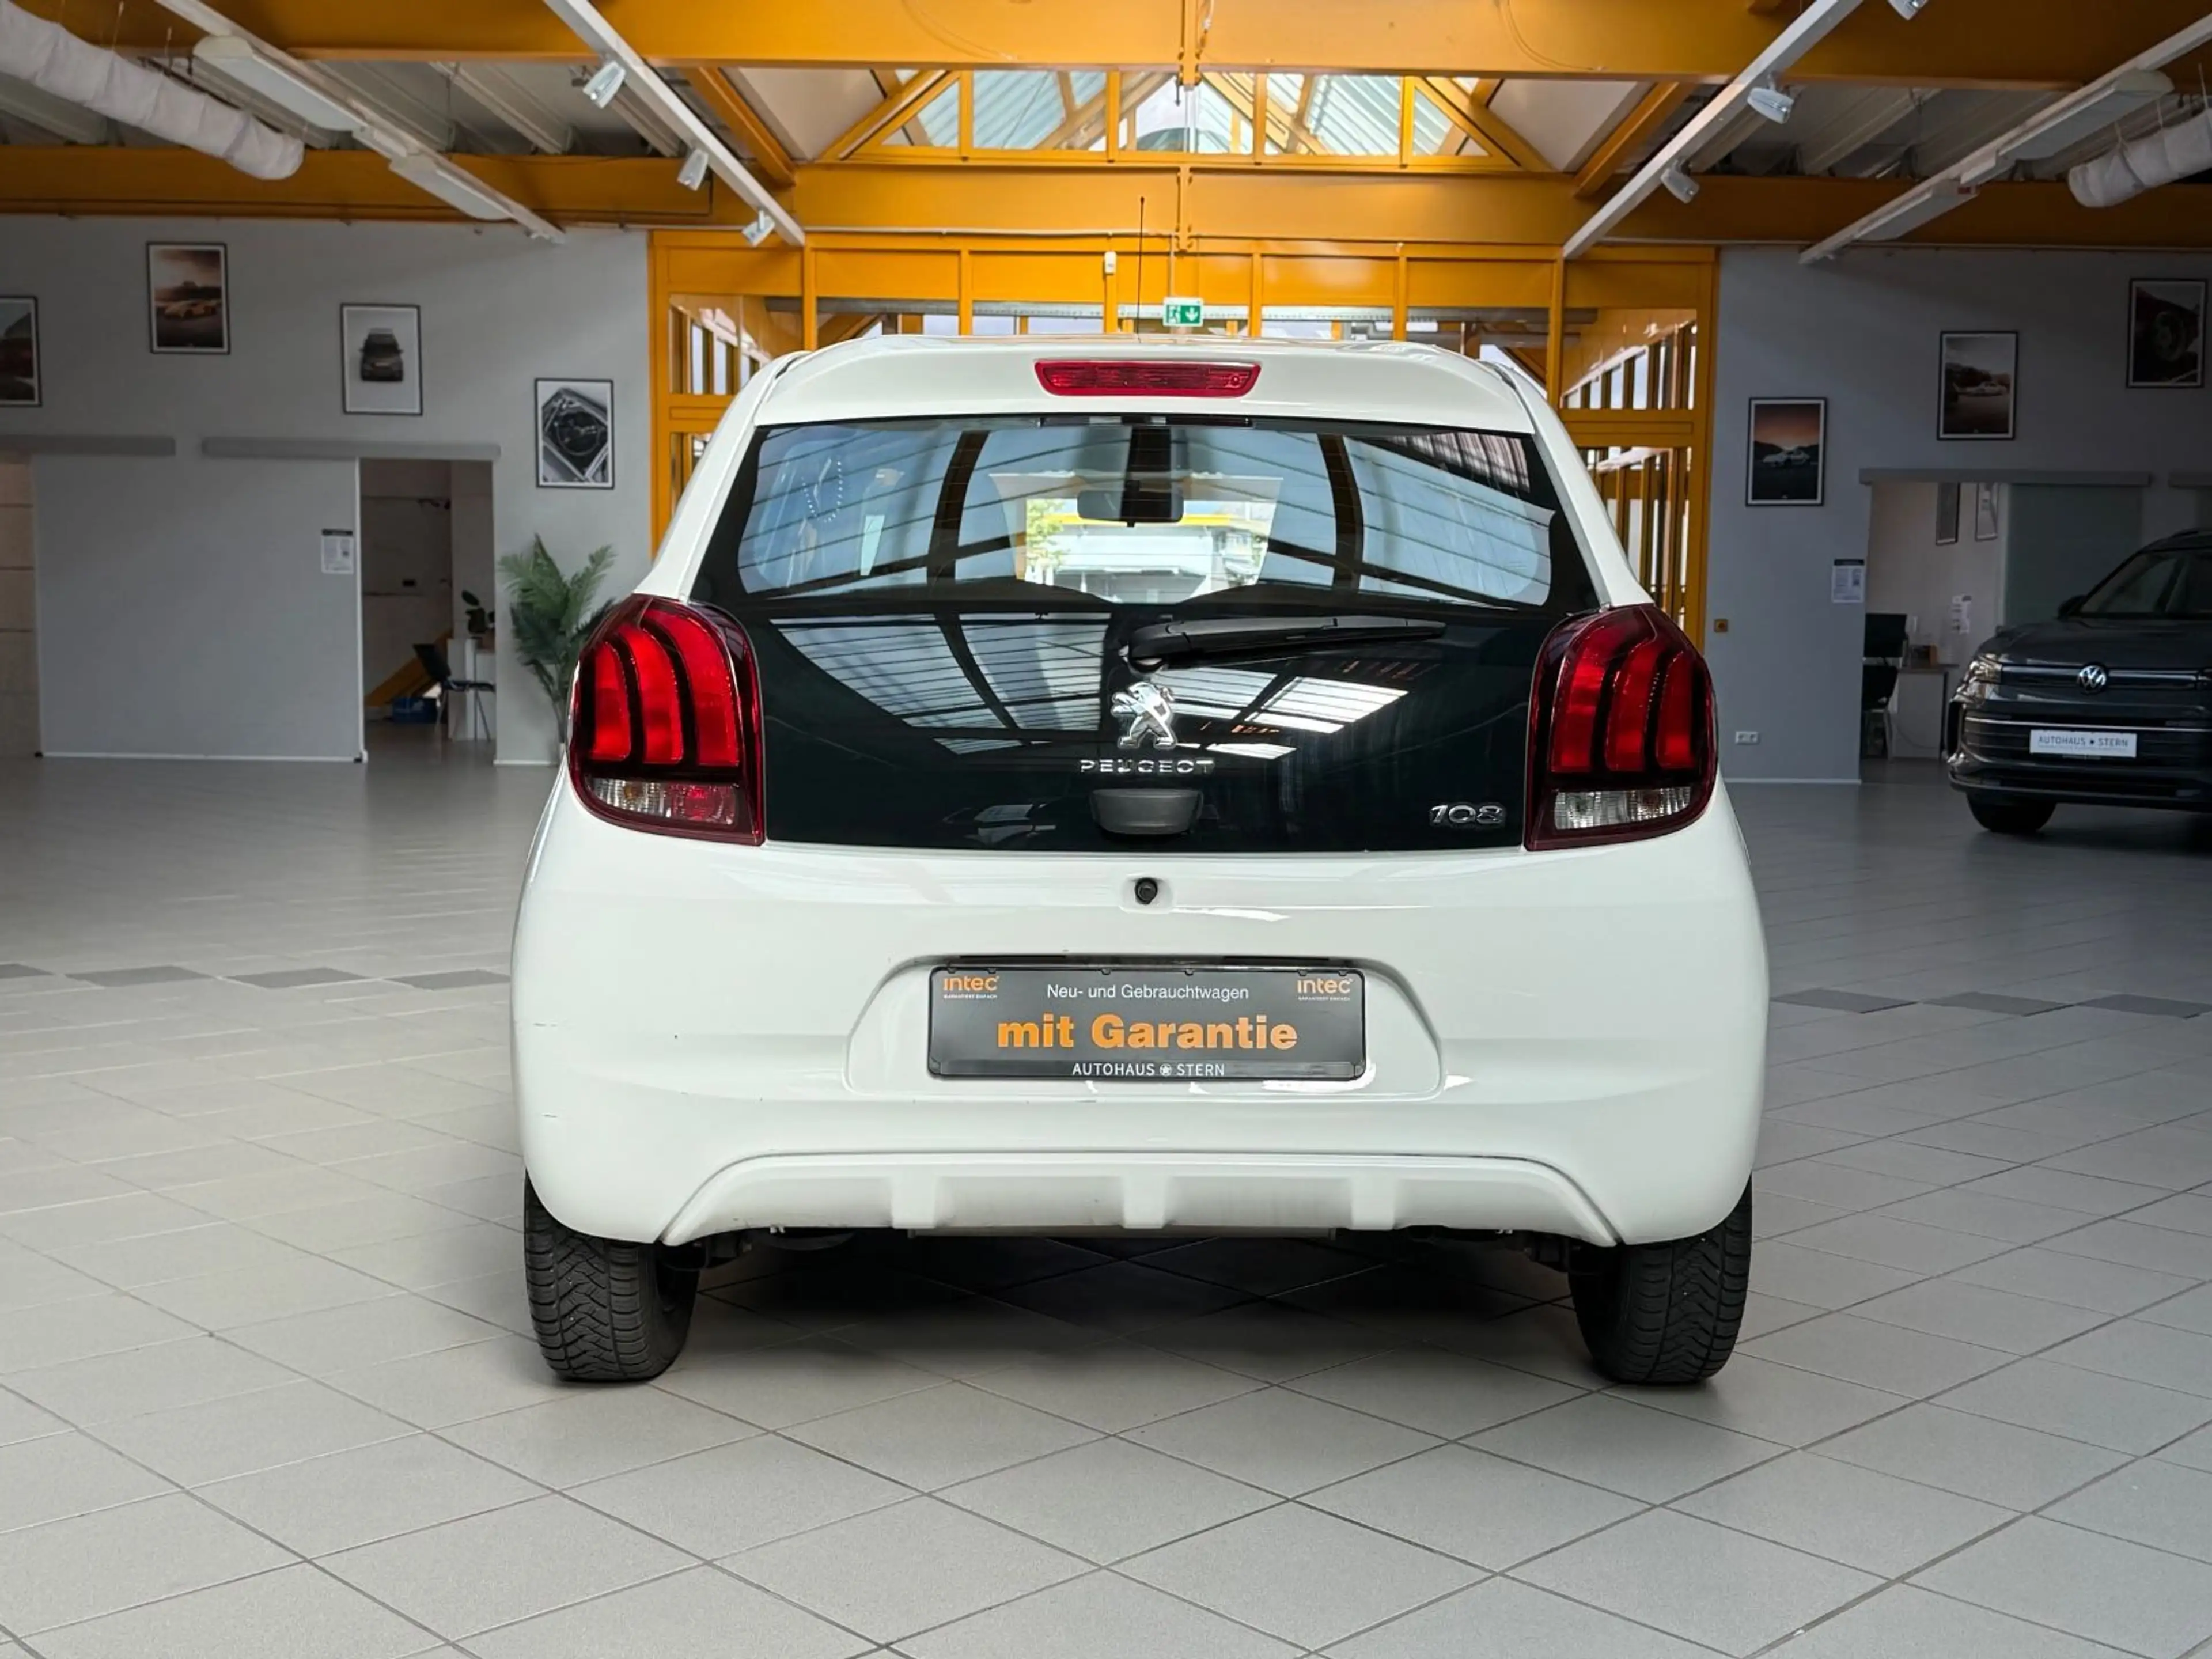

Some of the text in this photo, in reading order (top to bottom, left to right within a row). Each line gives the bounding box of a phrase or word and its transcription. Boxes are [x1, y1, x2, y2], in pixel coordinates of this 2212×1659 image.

[2039, 734, 2128, 748] AUTOHAUS STERN
[1080, 758, 1215, 774] PEUGEOT
[1430, 805, 1503, 824] 108
[943, 976, 999, 991] intec
[1297, 978, 1351, 994] intec
[1047, 984, 1249, 1002] Neu- und Gebrauchtwagen
[997, 1013, 1298, 1050] mit Garantie
[1072, 1063, 1225, 1077] AUTOHAUS STERN
